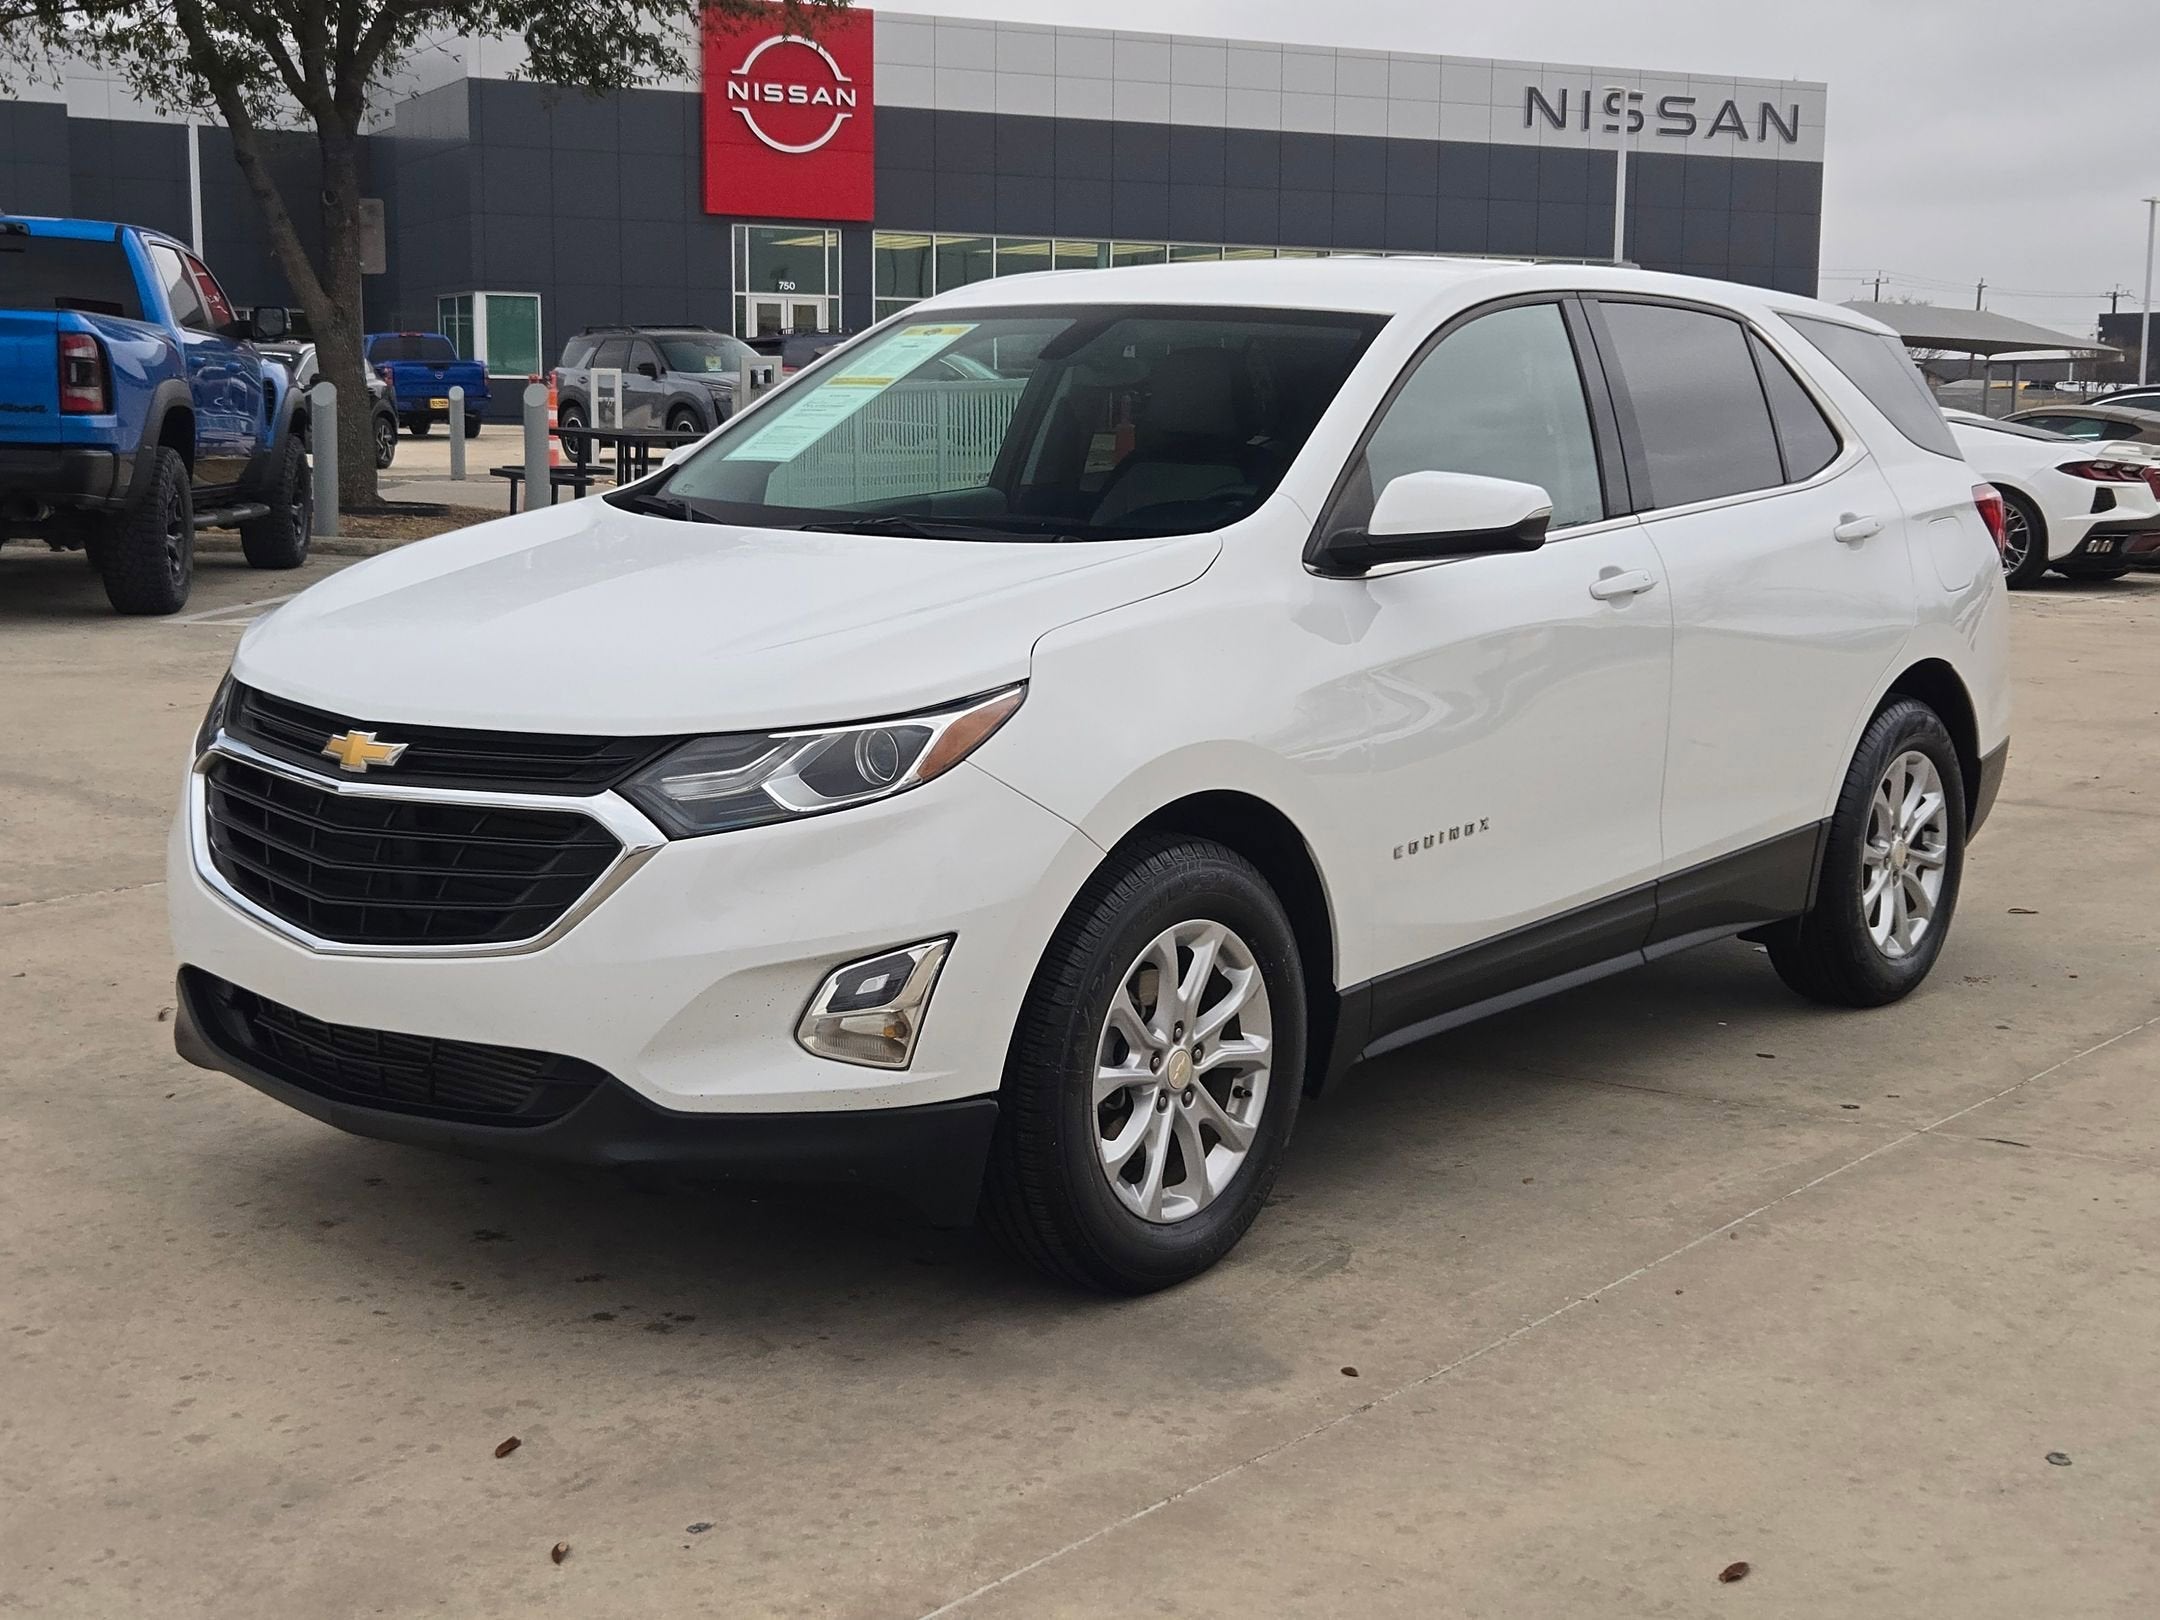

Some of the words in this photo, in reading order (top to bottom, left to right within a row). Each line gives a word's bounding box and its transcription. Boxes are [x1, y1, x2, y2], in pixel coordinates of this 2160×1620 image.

[728, 81, 856, 107] NISSAN
[1524, 86, 1800, 143] NISSAN
[778, 281, 796, 290] 750
[1393, 817, 1490, 860] EQUINOX
